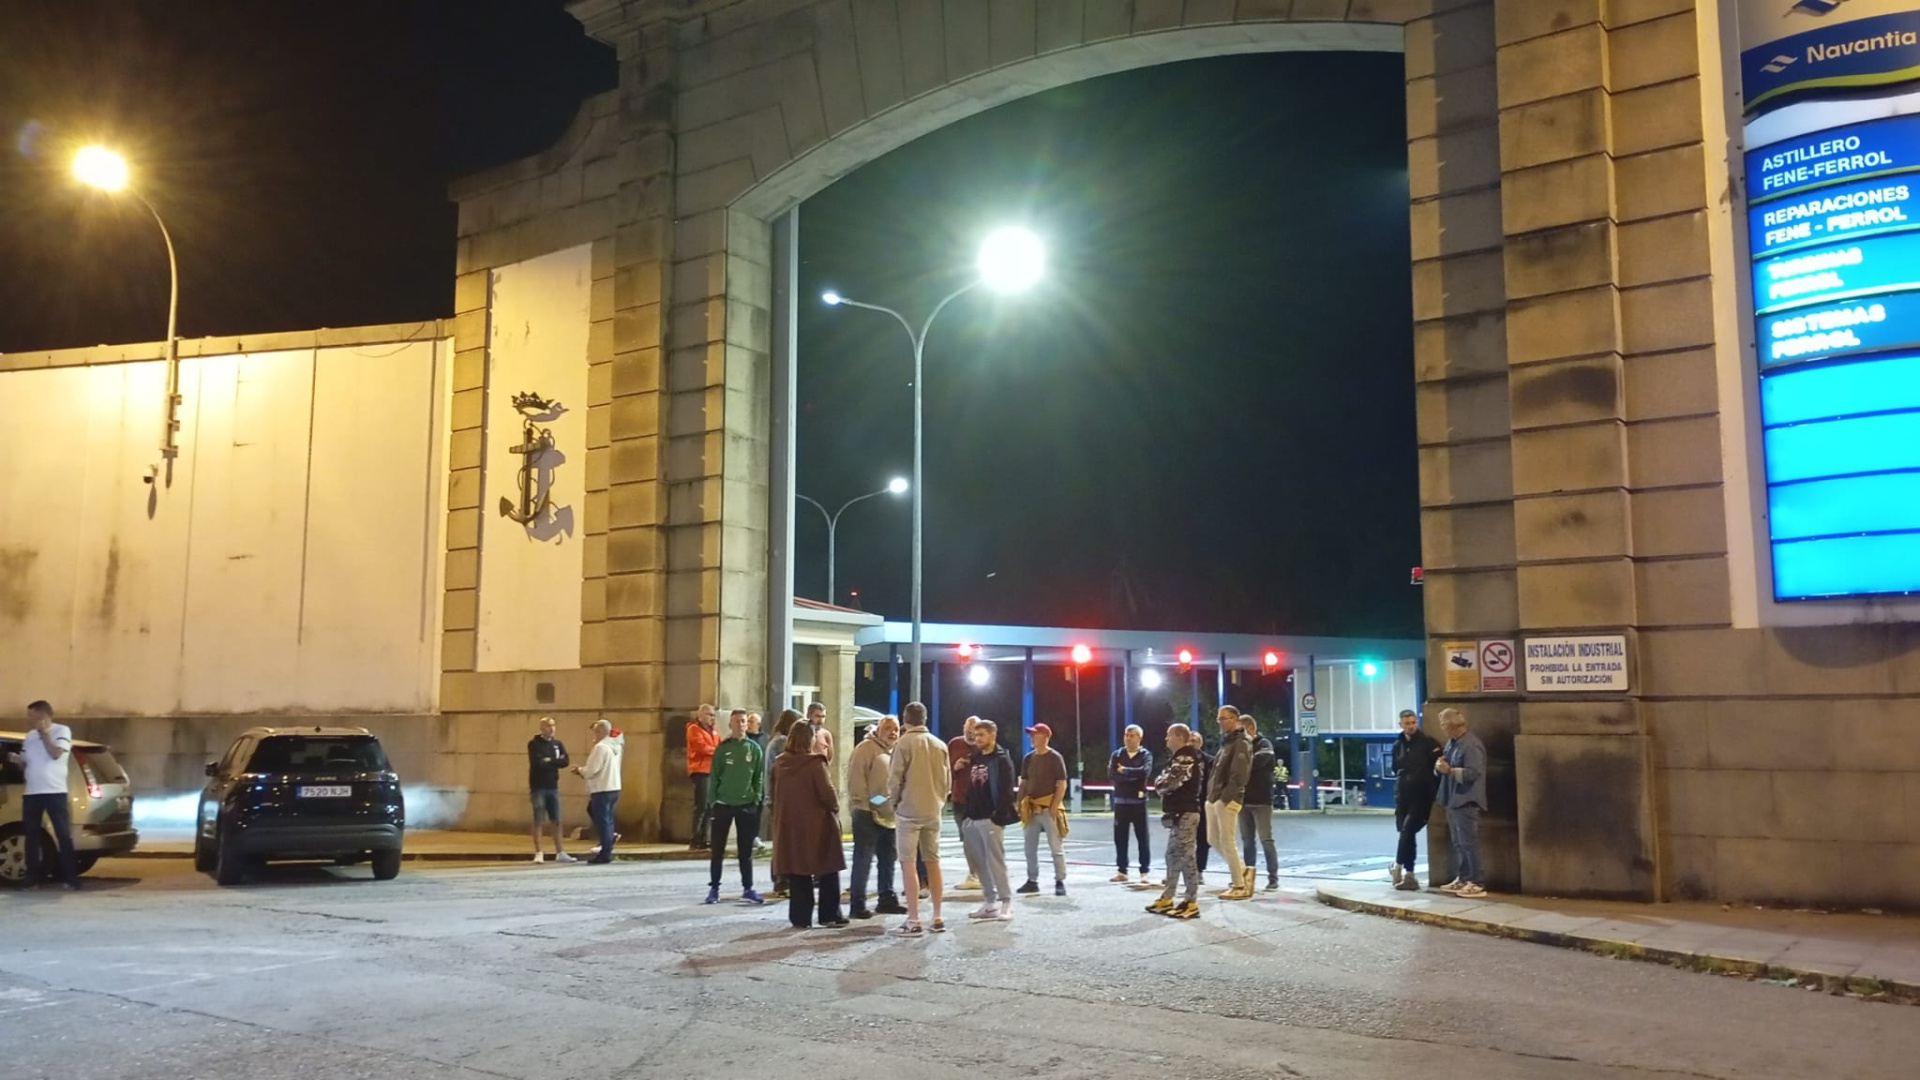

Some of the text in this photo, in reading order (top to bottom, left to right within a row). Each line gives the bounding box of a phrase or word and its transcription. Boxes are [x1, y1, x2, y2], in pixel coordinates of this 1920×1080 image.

[1806, 31, 1917, 64] Navantia
[1761, 136, 1861, 172] ASTILLERO
[1763, 151, 1892, 191] FENE-FERROL
[1764, 185, 1910, 227] REPARACIONES
[1765, 222, 1811, 246] FENE
[1826, 206, 1908, 232] FERROL
[1527, 640, 1623, 658] INSTALACIÓN INDUSTRIAL
[1530, 662, 1622, 673] PROHIBIDA LA ENTRADA
[1541, 674, 1613, 685] SIN AUTORIZACIÓN
